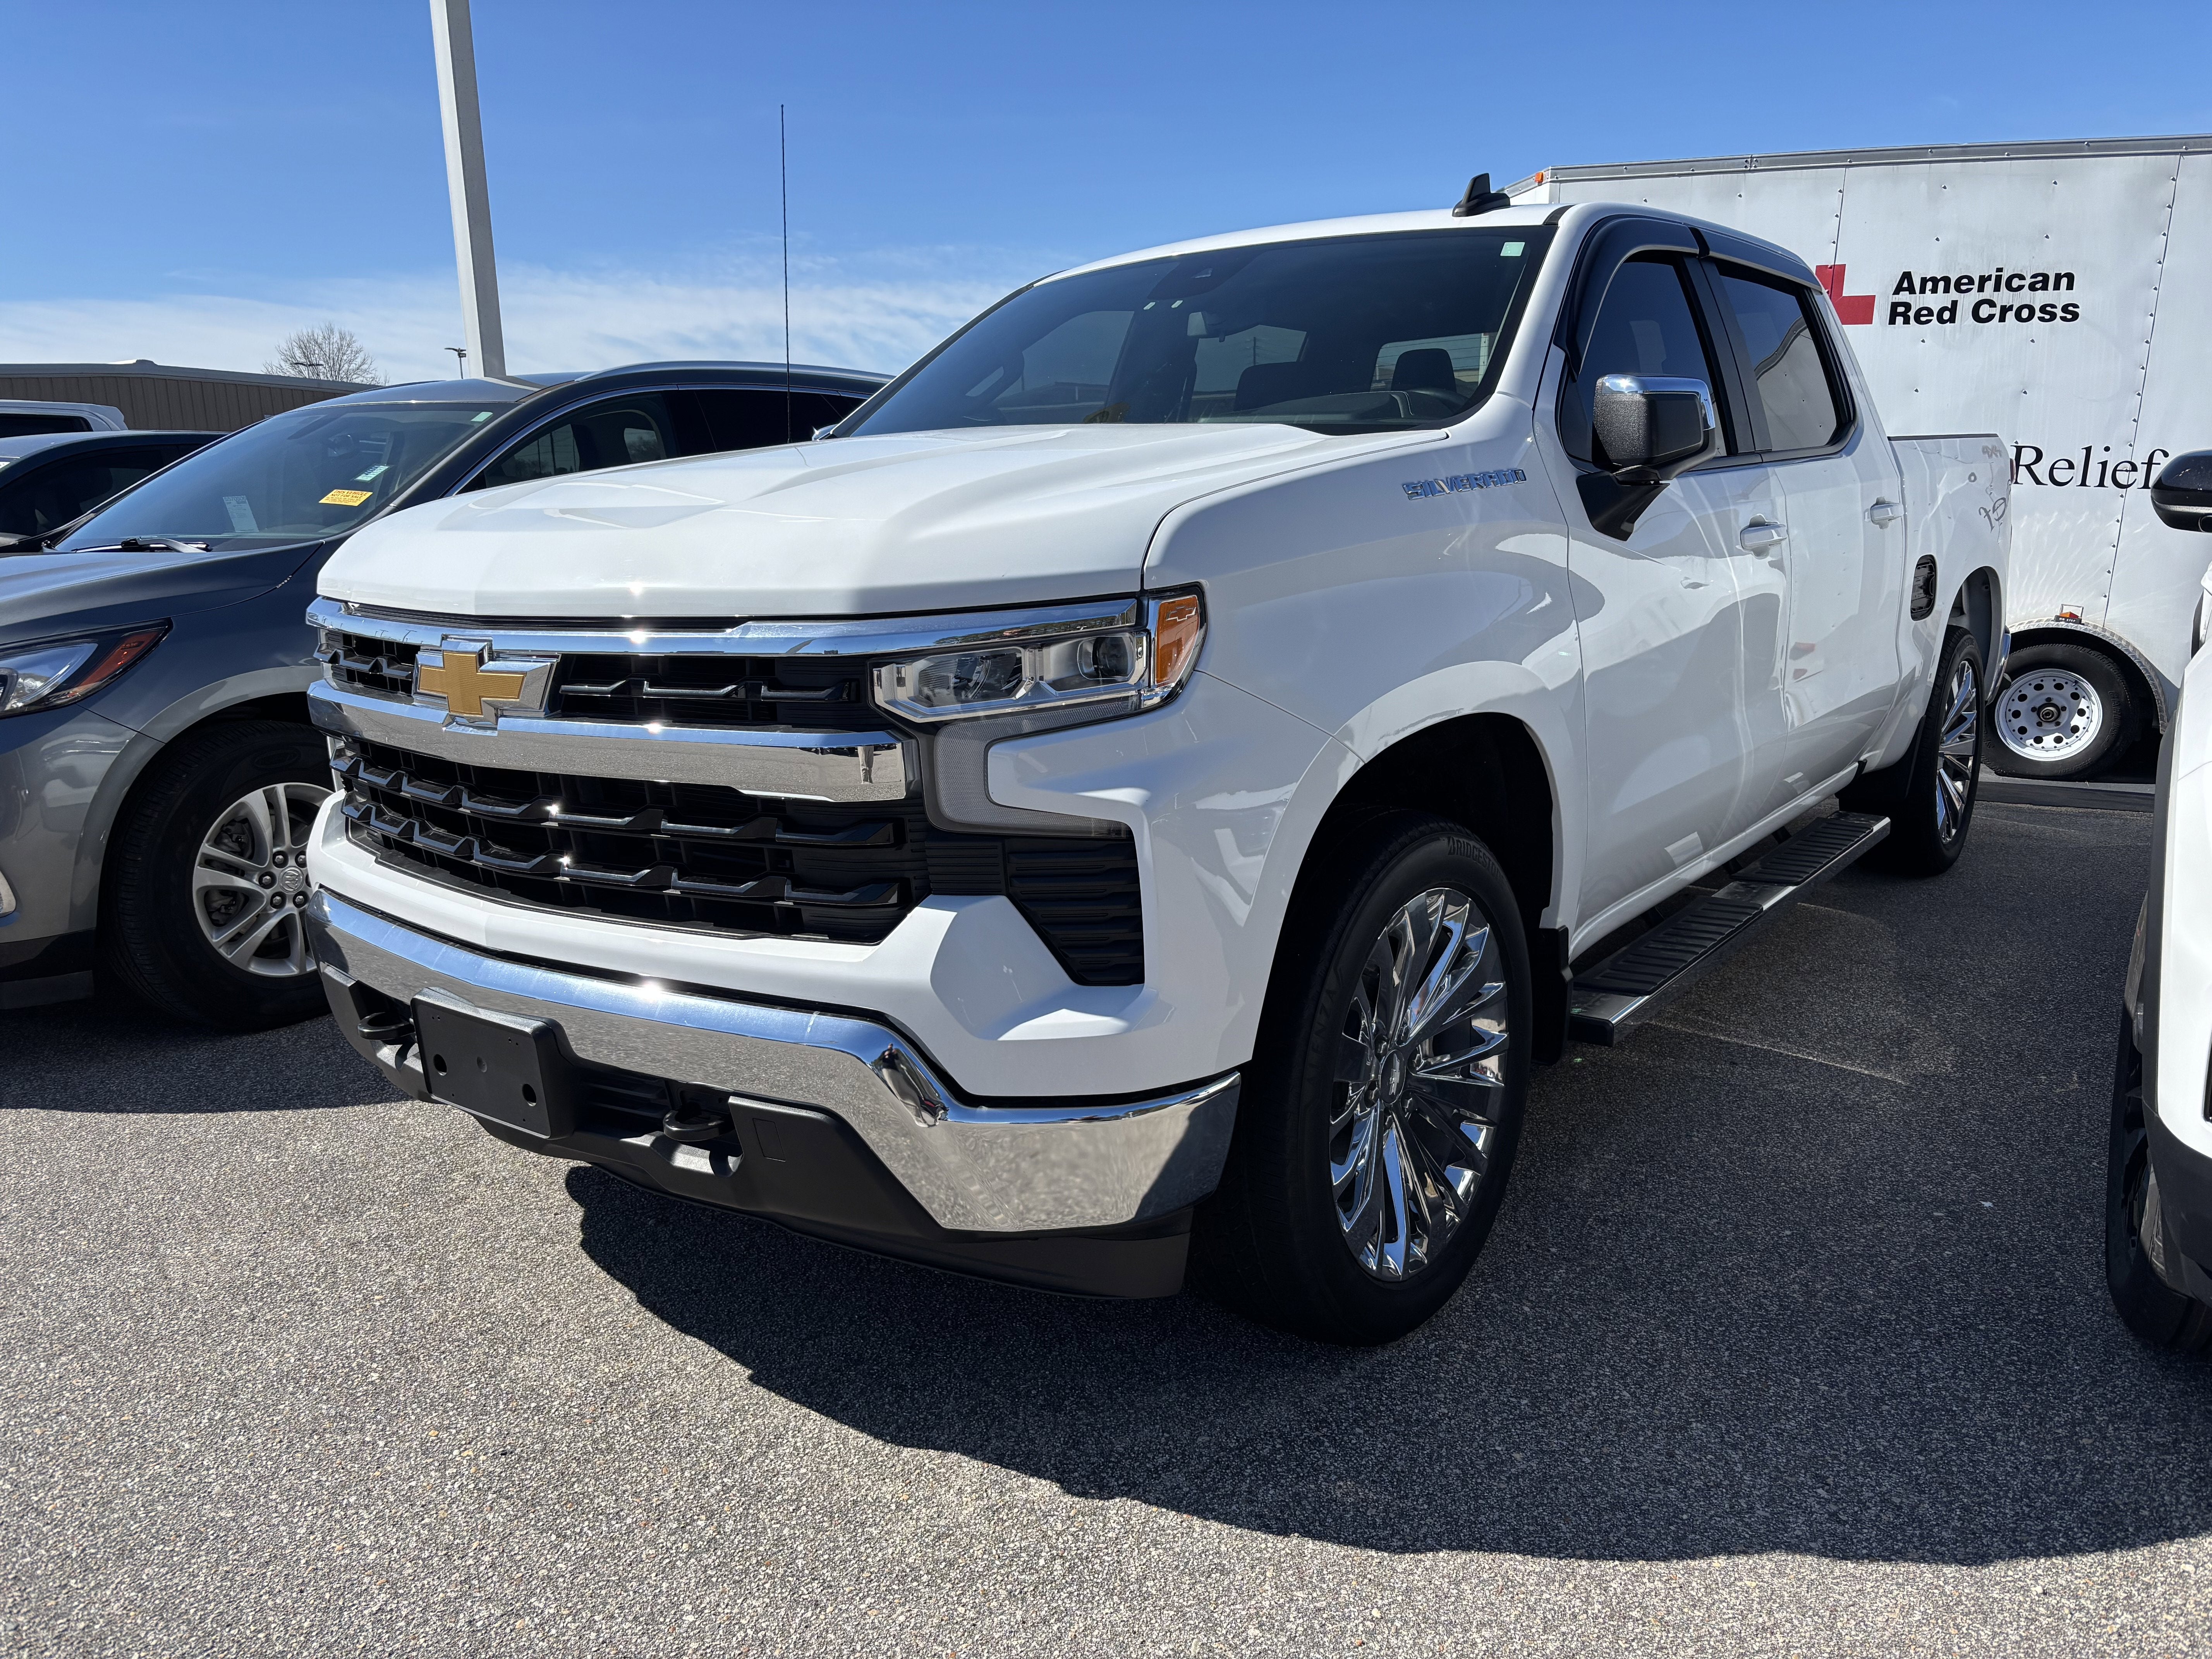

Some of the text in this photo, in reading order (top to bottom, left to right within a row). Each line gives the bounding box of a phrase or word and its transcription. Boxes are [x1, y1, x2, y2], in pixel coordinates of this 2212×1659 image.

[1892, 267, 2075, 295] American
[1888, 298, 2080, 325] Red Cross
[2010, 445, 2169, 489] Relief
[1402, 469, 1527, 501] SILVERADO
